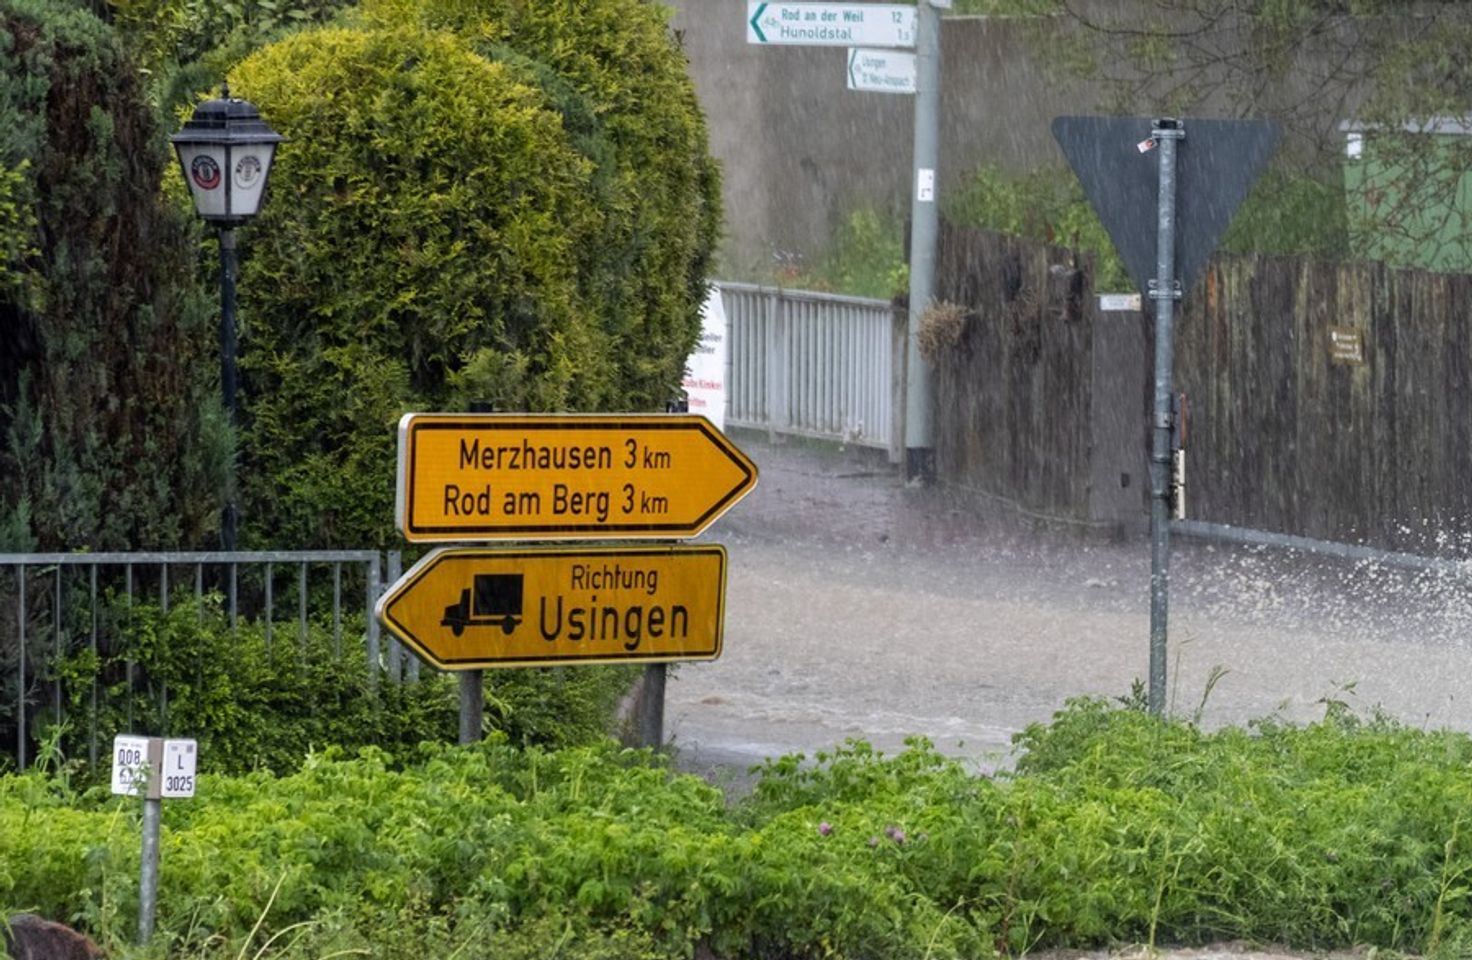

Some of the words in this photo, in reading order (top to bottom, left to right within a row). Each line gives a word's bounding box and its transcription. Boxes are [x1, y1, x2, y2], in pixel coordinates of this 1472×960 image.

[782, 8, 800, 20] Rod
[804, 12, 817, 20] an
[821, 10, 837, 21] der
[843, 10, 864, 22] Weil
[781, 26, 852, 39] Hunoldstal
[459, 438, 612, 470] Merzhausen
[624, 438, 637, 469] 3
[643, 446, 671, 469] km
[444, 484, 490, 515] Rod
[503, 492, 541, 515] am
[552, 484, 610, 522] Berg
[622, 484, 635, 514] 3
[641, 491, 669, 514] km
[571, 564, 658, 594] Richtung
[539, 595, 689, 651] Usingen
[178, 754, 184, 770] L
[166, 776, 193, 792] 3025
